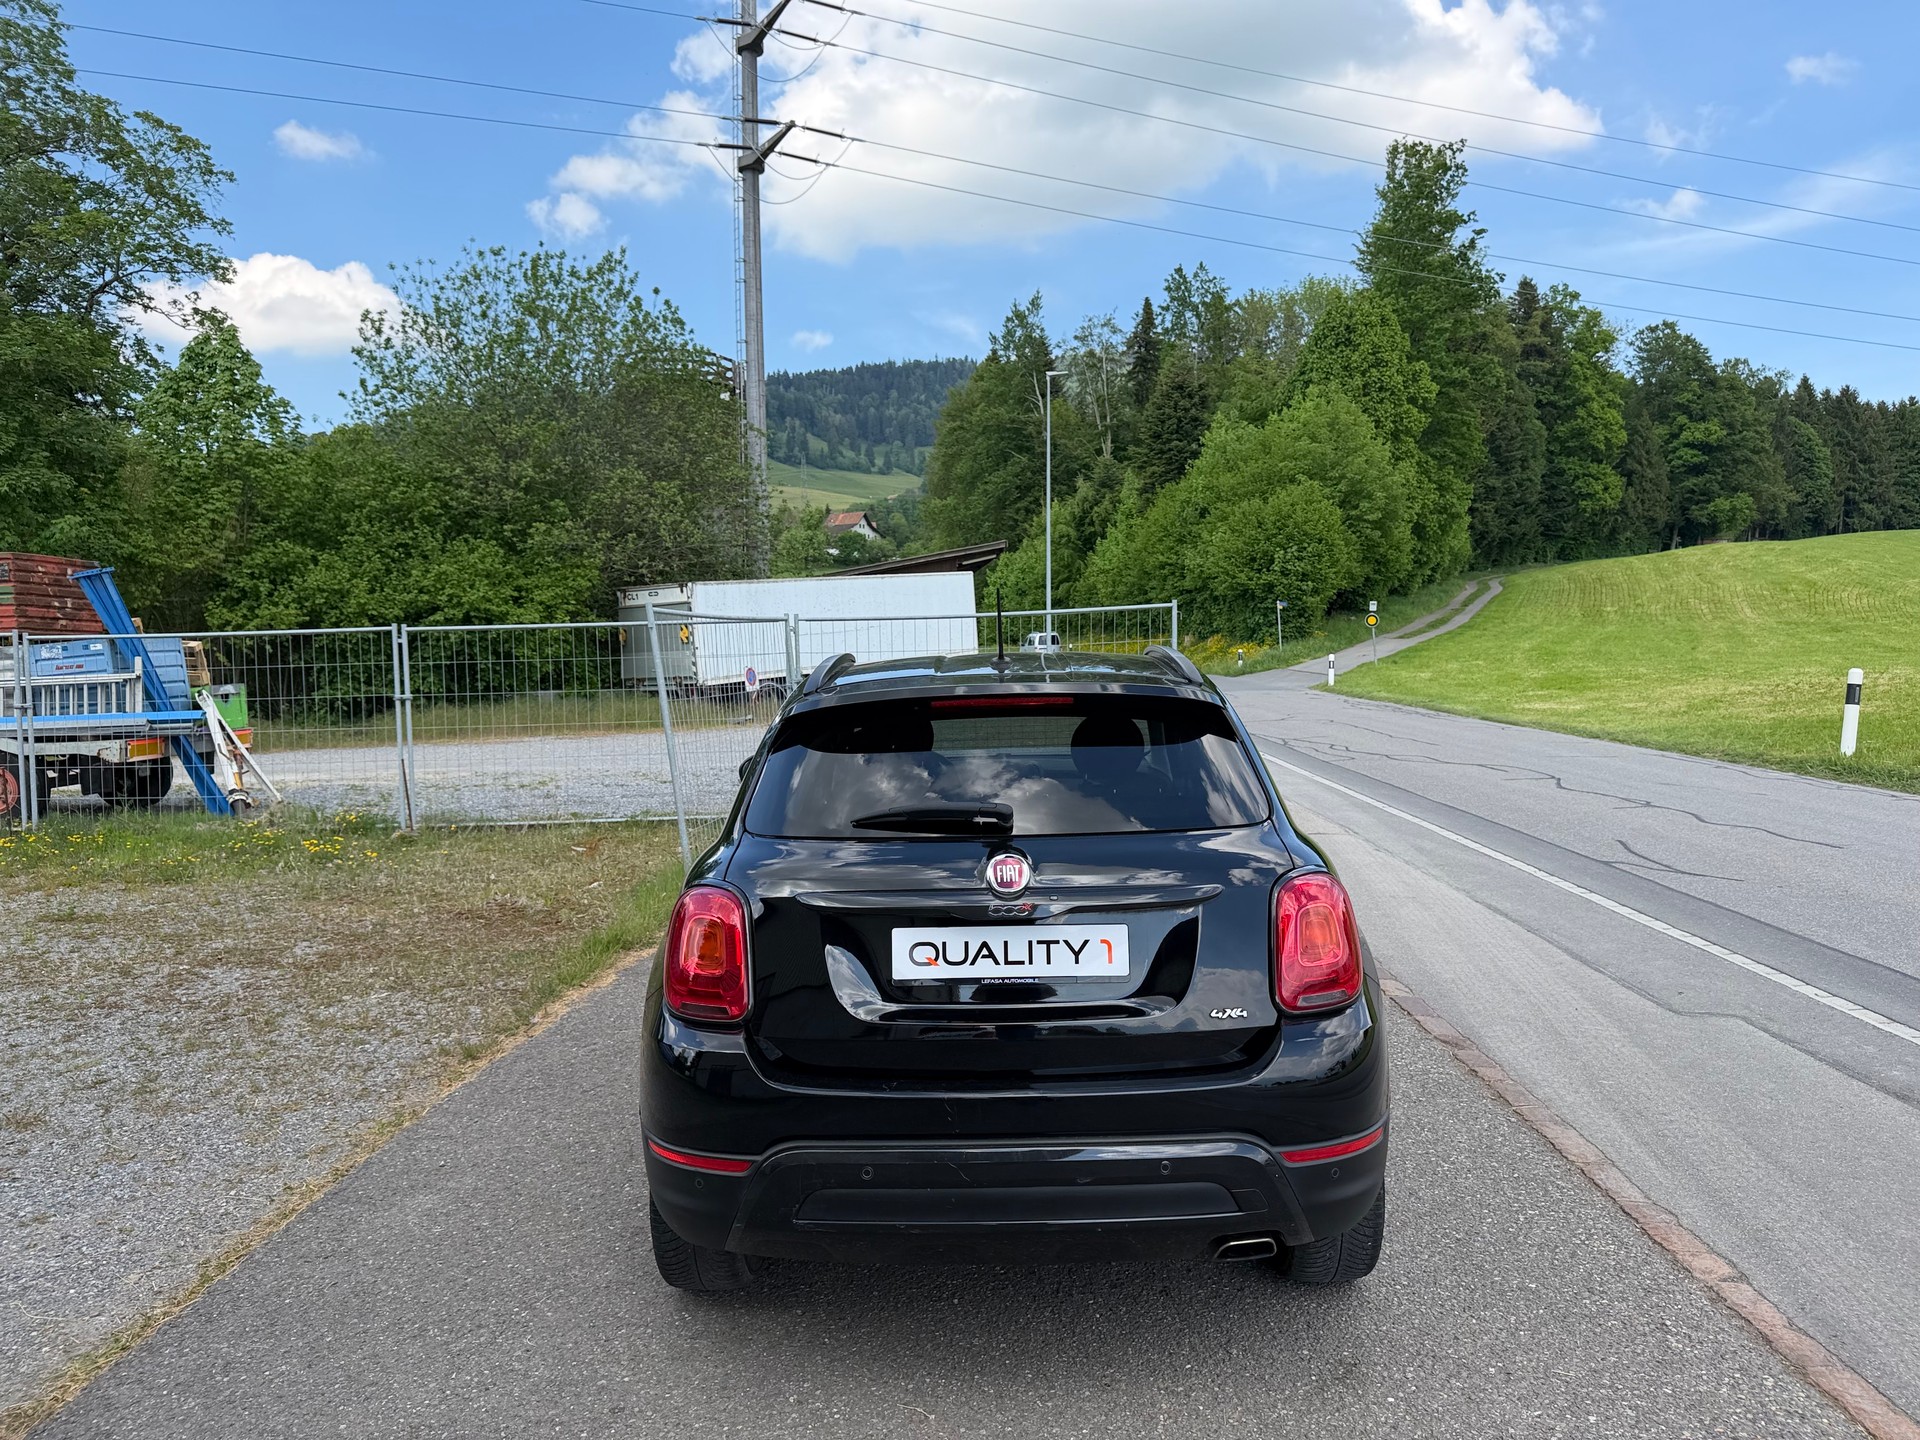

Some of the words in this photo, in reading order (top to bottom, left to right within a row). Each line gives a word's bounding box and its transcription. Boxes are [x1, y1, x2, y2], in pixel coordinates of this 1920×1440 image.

[996, 864, 1020, 883] FIAT
[908, 938, 1090, 967] QUALITY
[1099, 938, 1113, 965] 1
